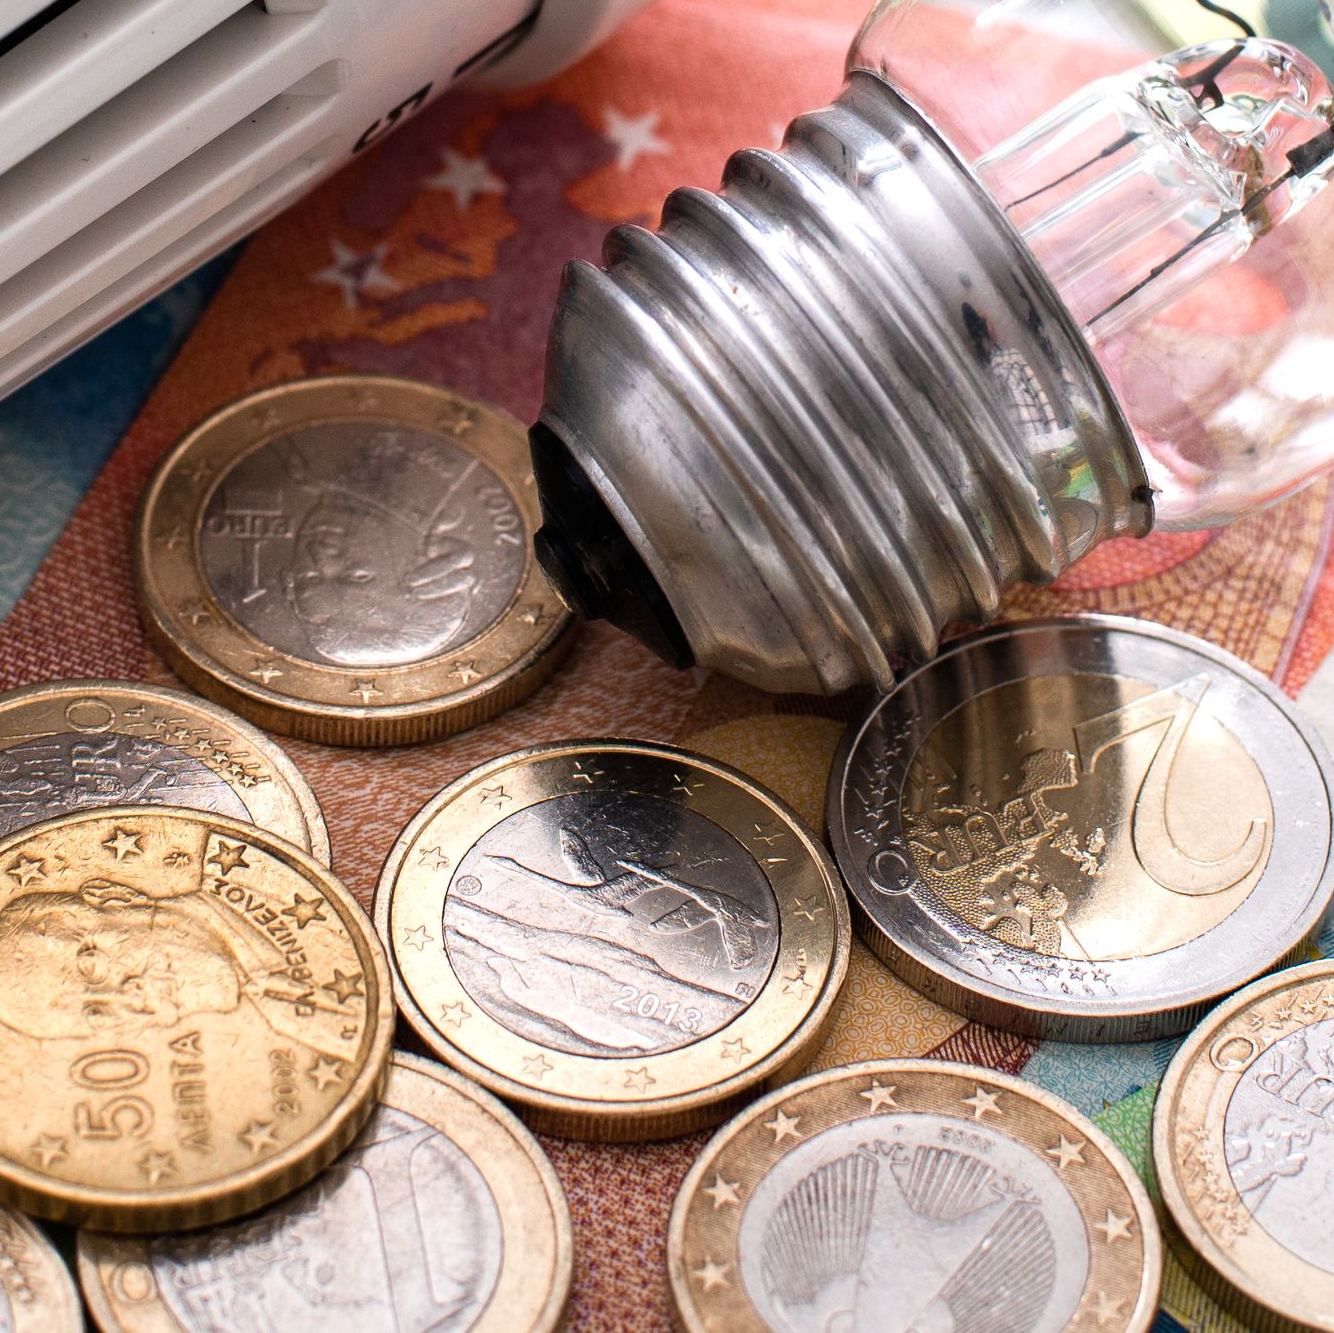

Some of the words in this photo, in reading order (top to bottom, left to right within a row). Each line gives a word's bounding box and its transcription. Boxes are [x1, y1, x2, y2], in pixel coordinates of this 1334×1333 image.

[1071, 671, 1268, 897] 2
[611, 984, 705, 1037] 2013
[68, 1048, 156, 1141] 50
[268, 1047, 302, 1117] 2002
